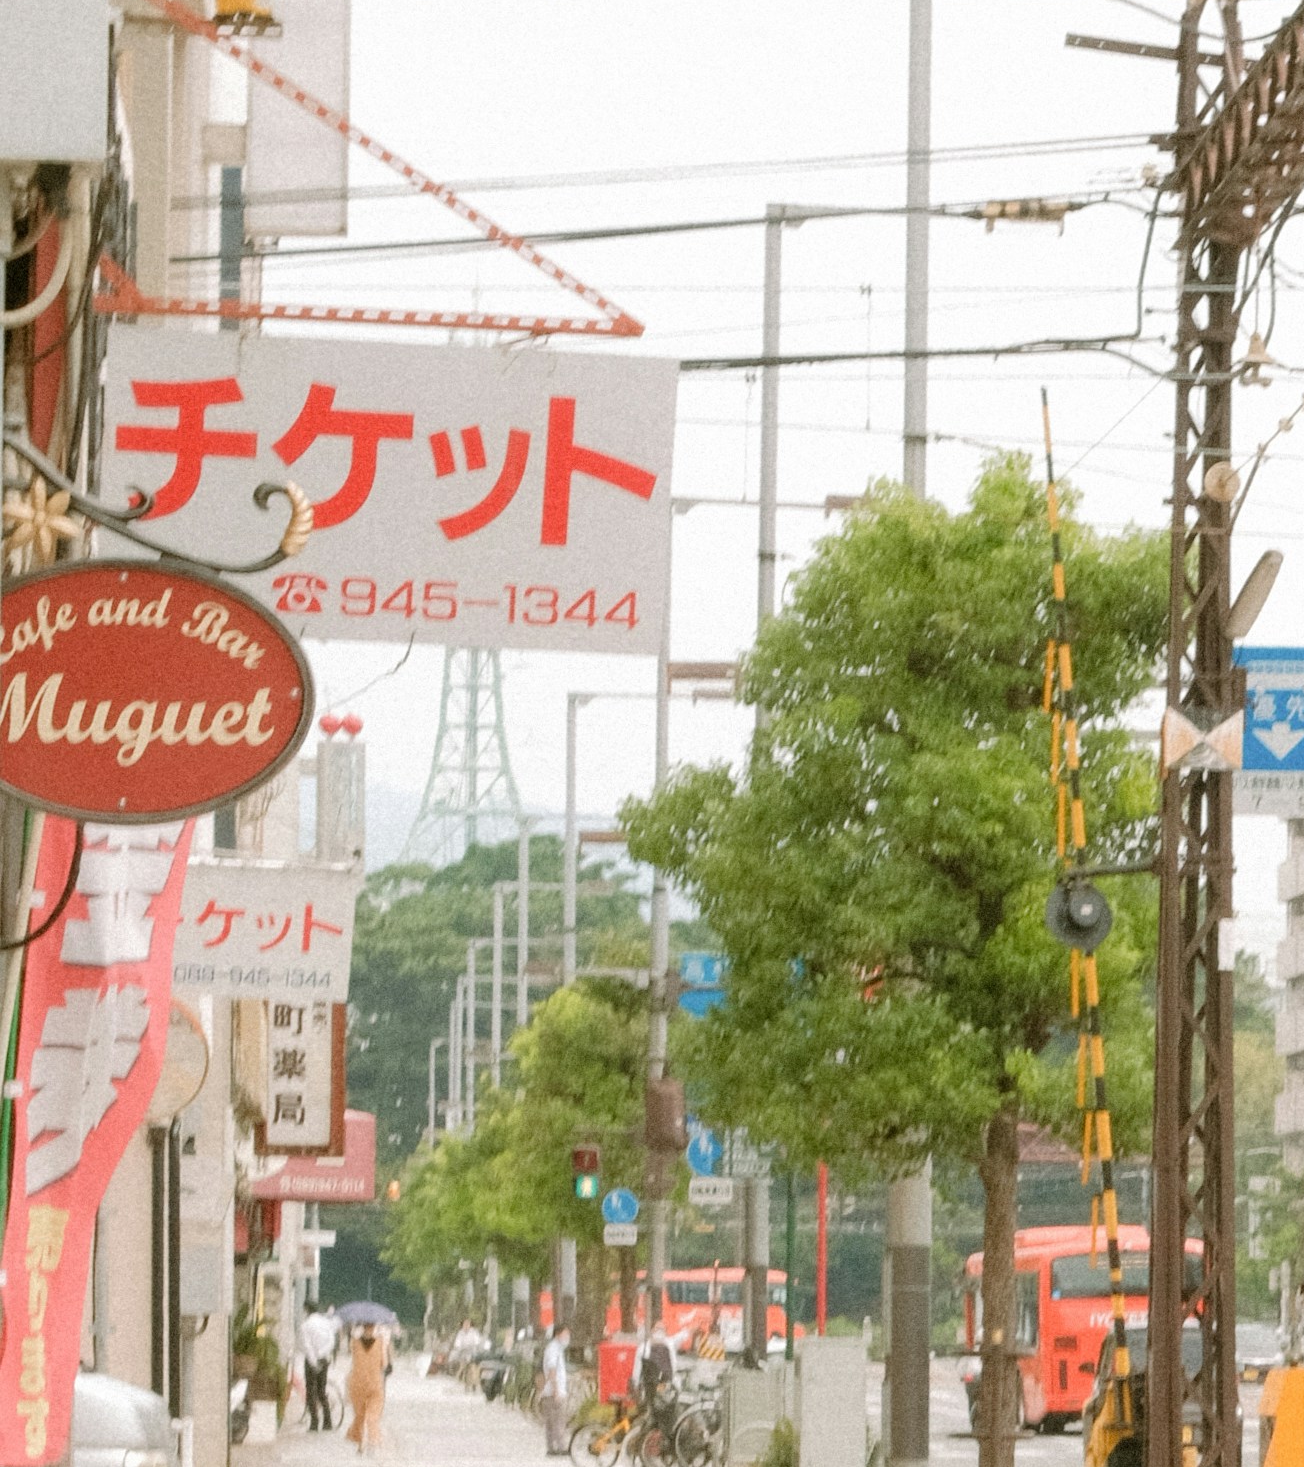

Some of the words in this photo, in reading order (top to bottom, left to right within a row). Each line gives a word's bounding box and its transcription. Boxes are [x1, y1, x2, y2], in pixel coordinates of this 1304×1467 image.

[115, 378, 657, 547] チケット
[88, 587, 173, 629] and
[181, 600, 266, 670] Bar
[340, 575, 641, 630] 945-1344
[0, 671, 275, 768] Muguet
[176, 898, 343, 954] ケット
